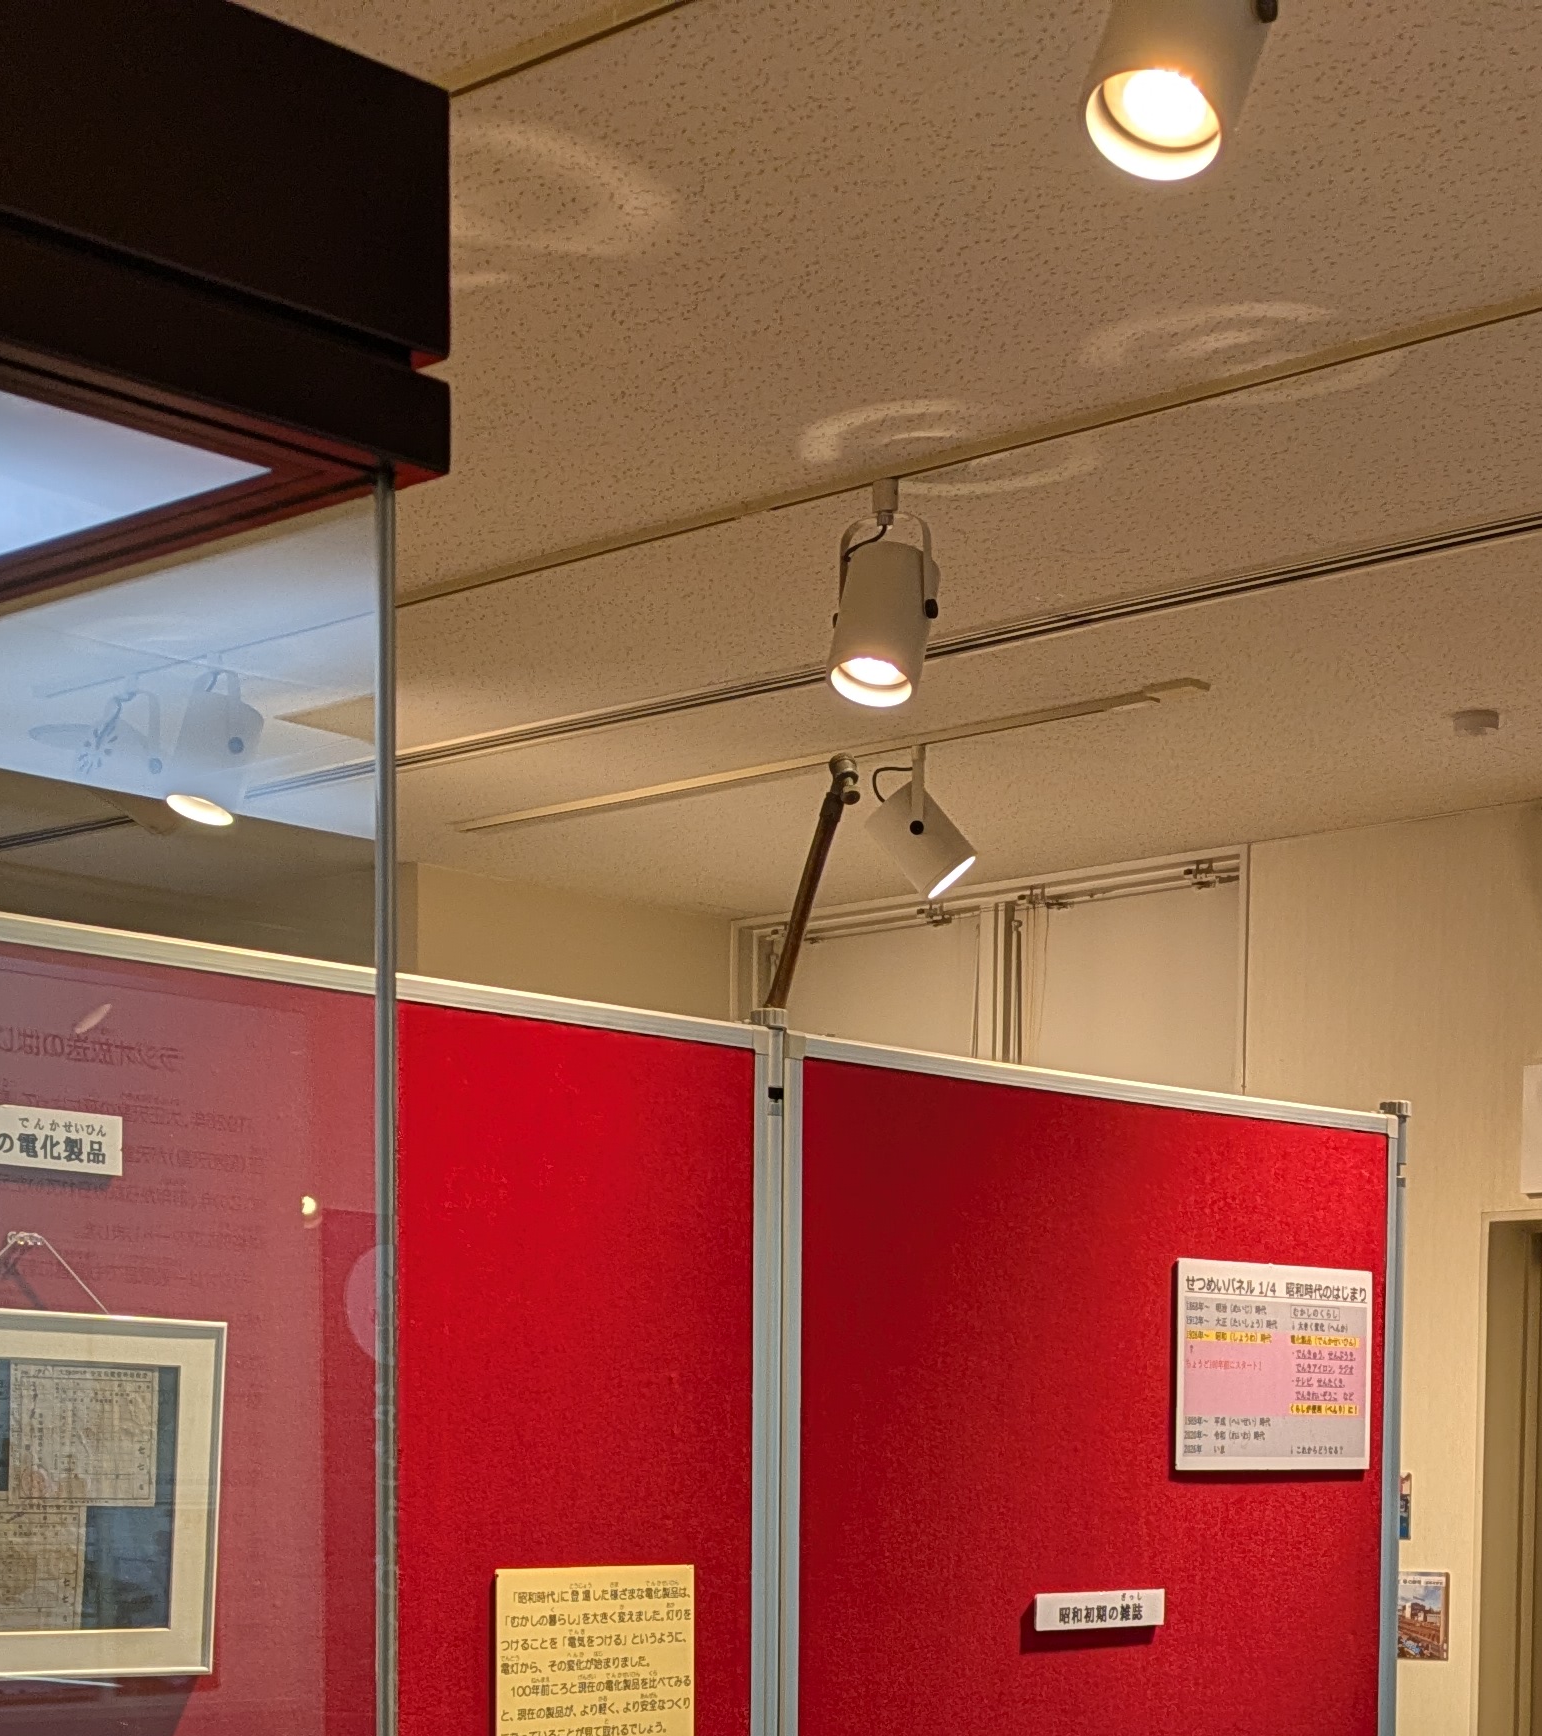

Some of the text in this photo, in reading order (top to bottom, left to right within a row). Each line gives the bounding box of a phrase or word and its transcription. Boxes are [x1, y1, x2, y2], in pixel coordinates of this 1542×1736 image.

[17, 1116, 108, 1139] でんかせいひん
[1185, 1275, 1367, 1303] せつめいパネル 1/4 昭和時代のはじまり
[1293, 1307, 1339, 1319] むかしのくらし
[1058, 1602, 1144, 1625] 昭和初期の雑誌
[500, 1655, 651, 1676] 電灯から、その変化が始まりました。
[510, 1675, 692, 1698] 100年前ころと現在の電化製品を比べてみる
